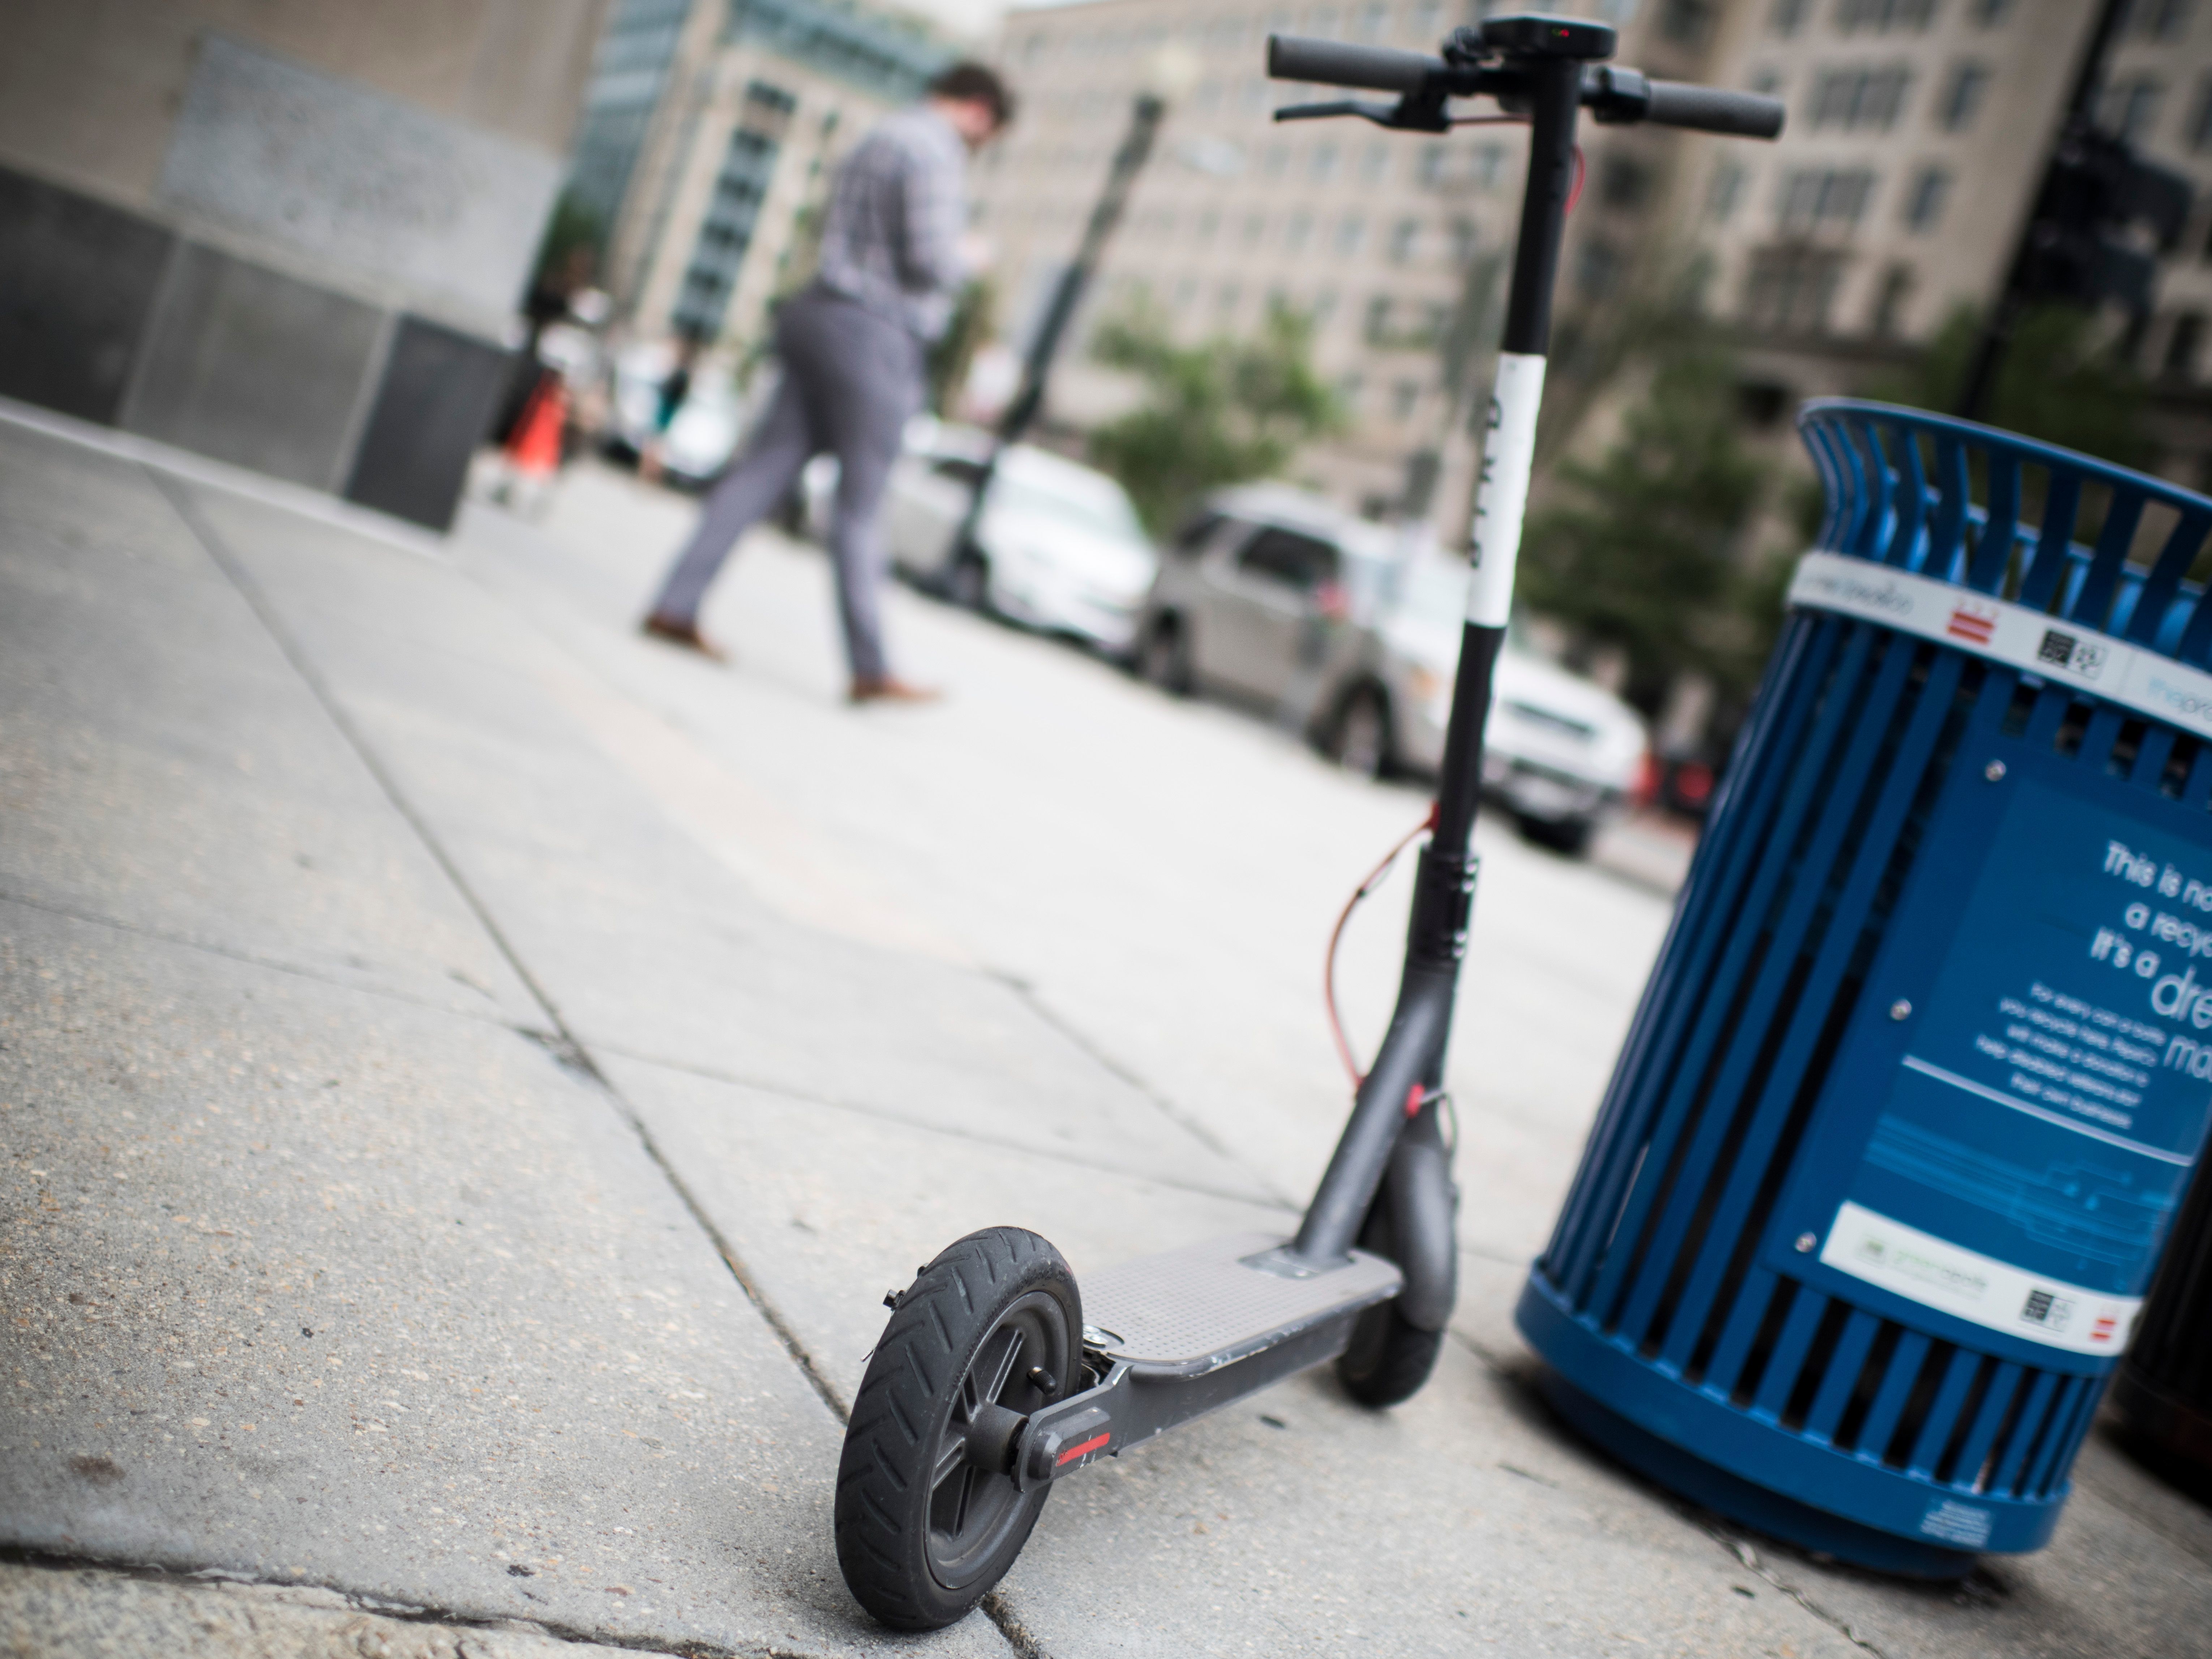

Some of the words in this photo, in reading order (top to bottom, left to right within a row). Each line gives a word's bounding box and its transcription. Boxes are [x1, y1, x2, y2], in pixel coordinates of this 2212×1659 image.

[2104, 839, 2156, 887] This
[2158, 863, 2182, 898] is
[2125, 901, 2151, 930] a
[2135, 951, 2161, 979] a
[2151, 965, 2212, 1030] dre
